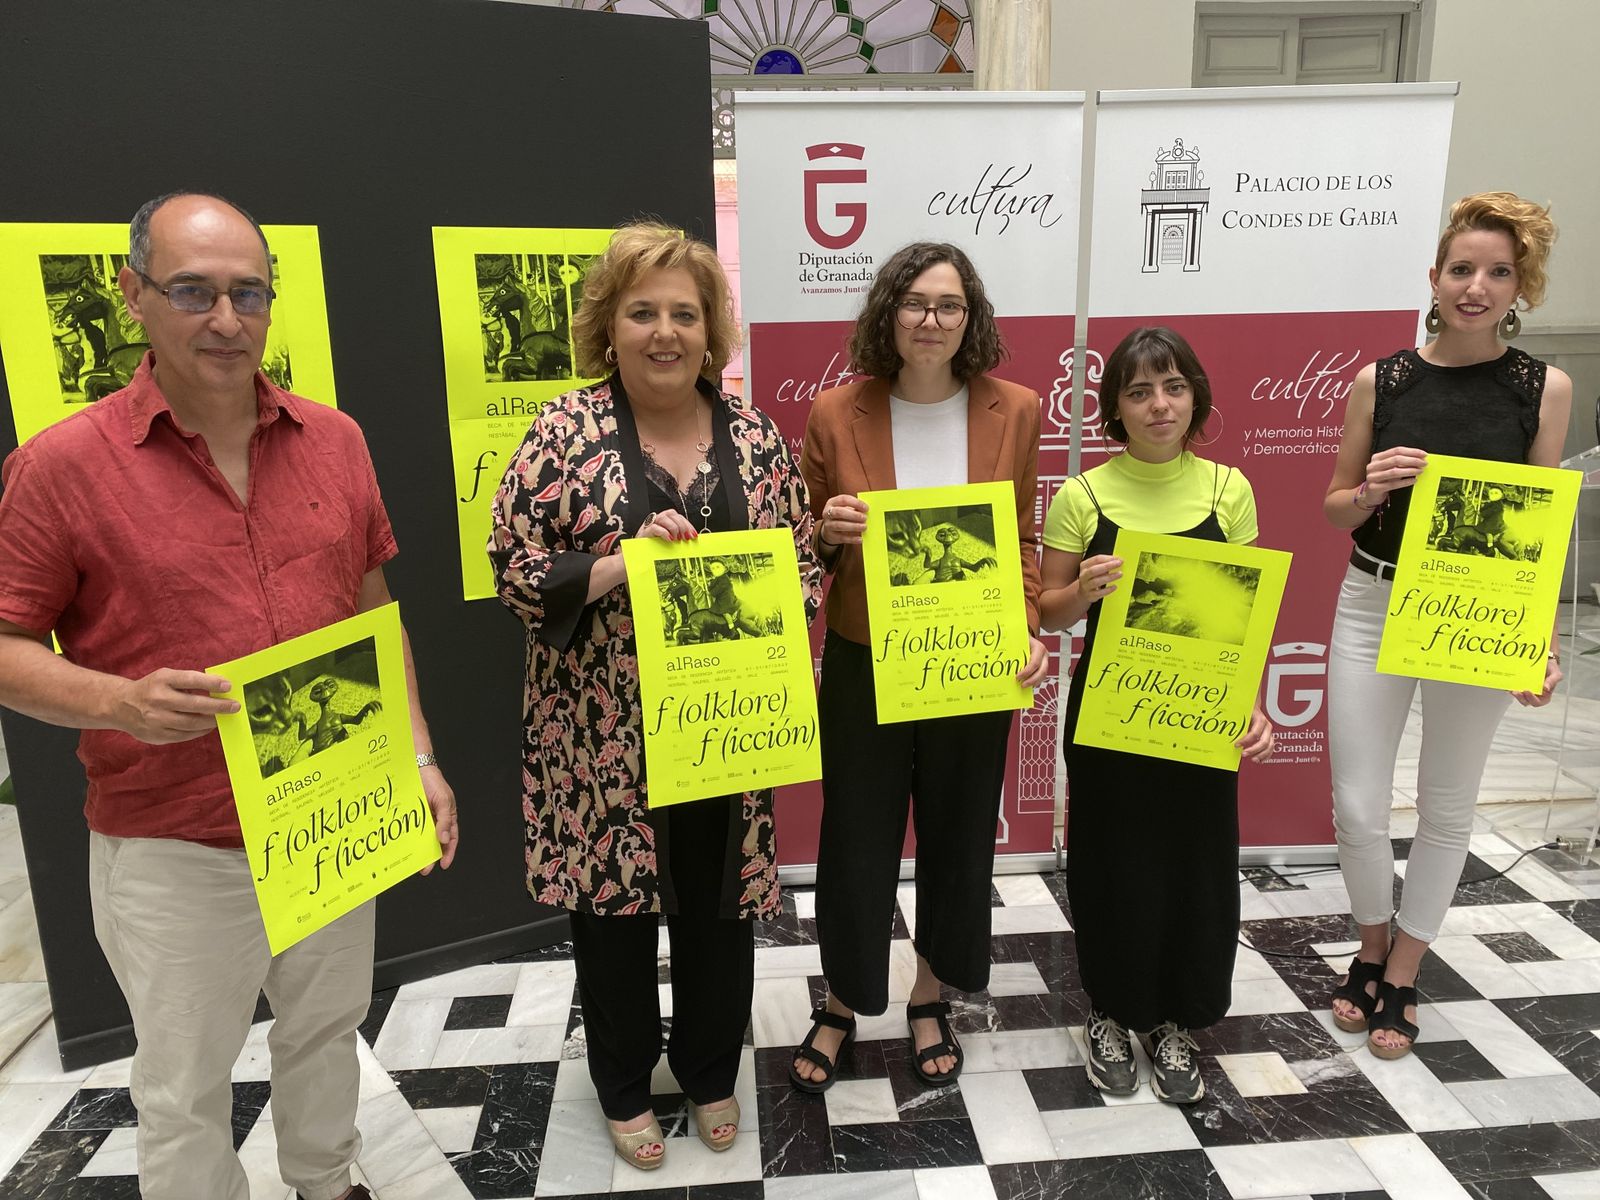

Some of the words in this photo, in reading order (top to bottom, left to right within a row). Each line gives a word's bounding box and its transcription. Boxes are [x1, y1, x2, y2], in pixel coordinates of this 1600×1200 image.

[927, 163, 1063, 235] cultura
[1235, 172, 1321, 193] PALACIO
[1326, 175, 1352, 191] DE
[1357, 173, 1393, 191] LOS
[1221, 209, 1303, 230] CONDES
[1308, 211, 1333, 228] DE
[1339, 207, 1398, 227] GABIA
[798, 252, 874, 269] Diputación
[798, 268, 815, 283] de
[817, 268, 874, 283] Granada
[800, 286, 843, 295] Avanzamos
[776, 352, 854, 402] cult
[1250, 350, 1361, 419] cultur
[1243, 446, 1250, 457] y
[1253, 442, 1340, 456] Democrática
[1244, 429, 1252, 442] y
[1255, 426, 1313, 439] Memoria
[1316, 424, 1345, 437] Histó
[460, 449, 498, 503] f
[1420, 559, 1471, 575] alRaso
[1516, 570, 1536, 583] 22
[891, 595, 939, 609] alRaso
[983, 588, 1001, 600] 22
[1390, 588, 1420, 616] f
[1417, 592, 1525, 633] (olklore)
[666, 657, 720, 672] alRaso
[767, 646, 786, 660] 22
[876, 629, 899, 663] f
[902, 621, 1002, 661] (olklore)
[1120, 636, 1172, 652] alRaso
[1219, 651, 1240, 664] 22
[1421, 623, 1452, 651] f
[1449, 627, 1546, 667] (icción)
[916, 657, 938, 690] f
[1089, 662, 1119, 688] f
[1117, 667, 1228, 710] (olklore)
[649, 696, 674, 735] f
[678, 682, 788, 734] (olklore)
[1120, 698, 1152, 724] f
[1149, 702, 1247, 743] (icción)
[693, 727, 719, 767] f
[722, 715, 816, 763] (icción)
[1272, 728, 1325, 740] putación
[1272, 741, 1324, 753] Granada
[267, 770, 322, 807] alRaso
[368, 735, 388, 755] 22
[258, 831, 279, 882] f
[287, 775, 393, 866] (olklore)
[309, 846, 329, 895] f
[336, 799, 426, 879] (icción)
